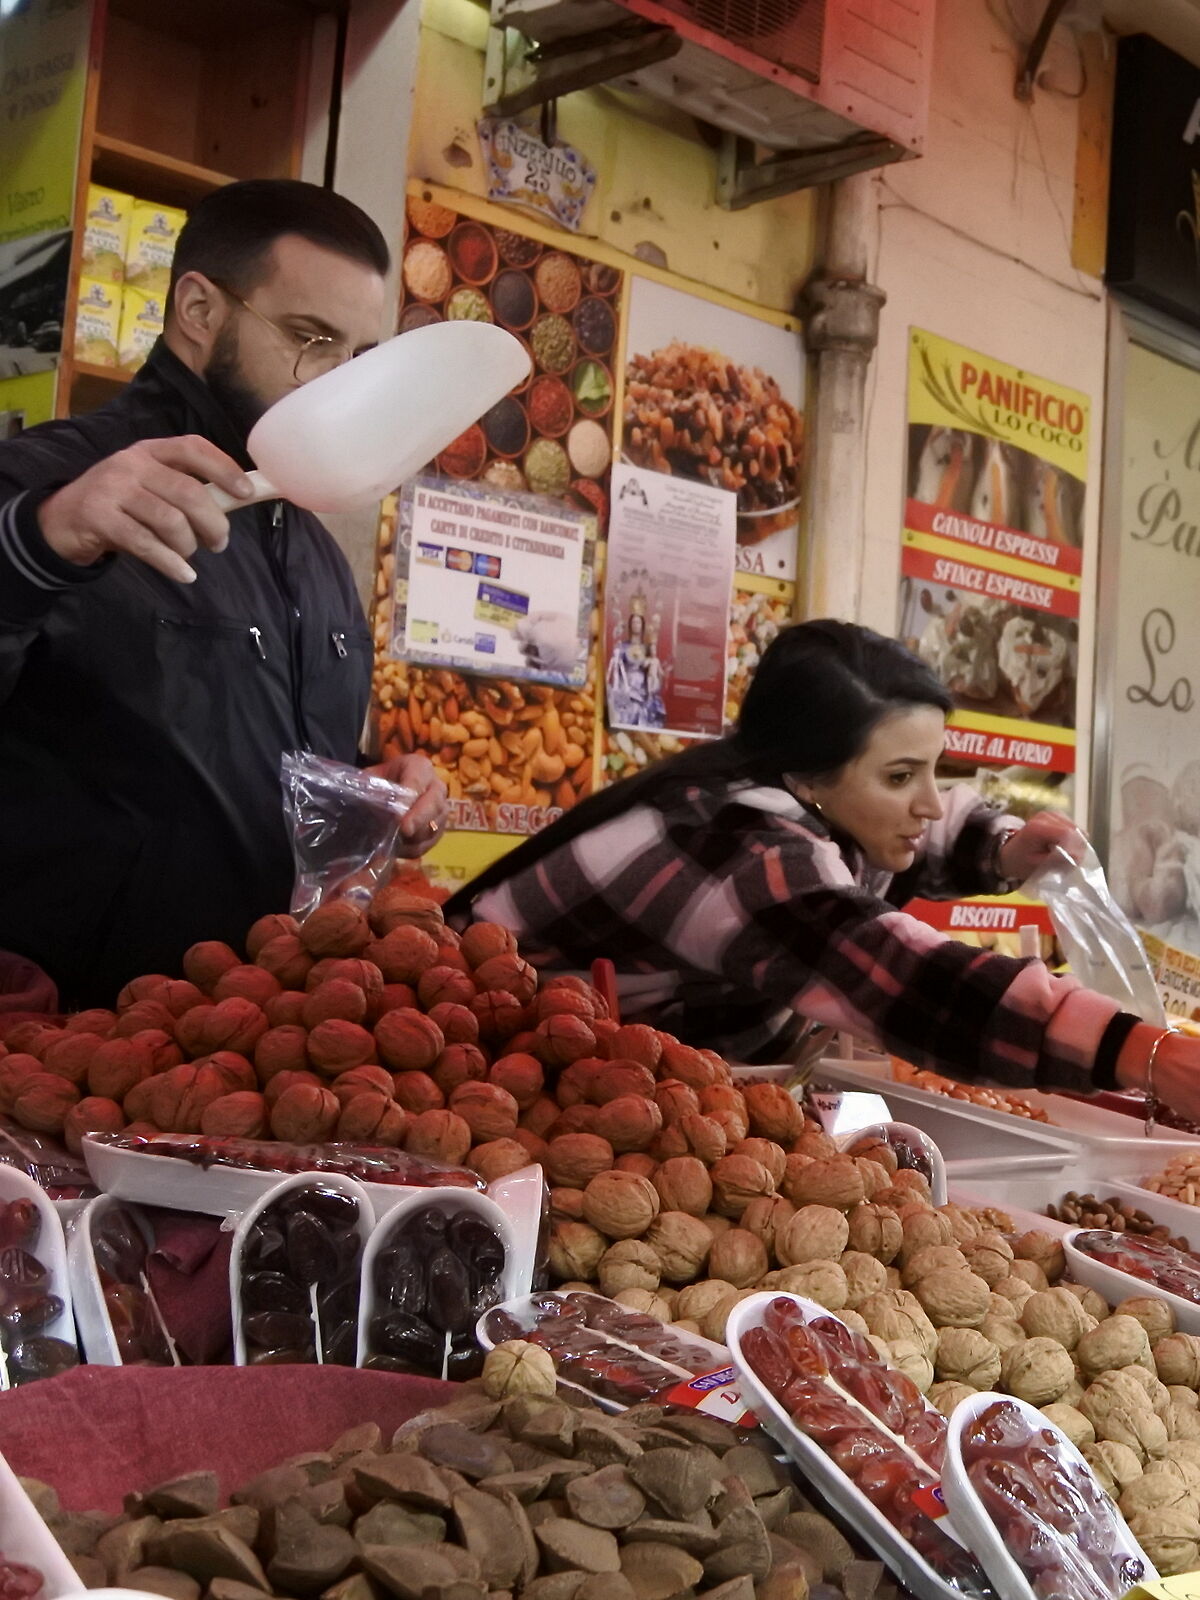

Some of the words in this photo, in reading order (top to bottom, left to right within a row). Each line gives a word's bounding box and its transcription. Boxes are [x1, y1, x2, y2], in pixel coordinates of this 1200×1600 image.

[524, 160, 551, 193] 25
[960, 361, 1084, 436] PANIFICIO
[993, 409, 1022, 431] LO
[1026, 422, 1083, 453] COCO
[932, 511, 993, 546] CANNOLI
[996, 526, 1060, 566] ESPRESSI
[932, 558, 985, 591] SFINCE
[986, 570, 1054, 609] ESPRESSE
[1126, 607, 1195, 713] Lo
[986, 737, 1006, 759] AL
[1008, 739, 1054, 766] FORNO
[950, 905, 1017, 928] BISCOTTI
